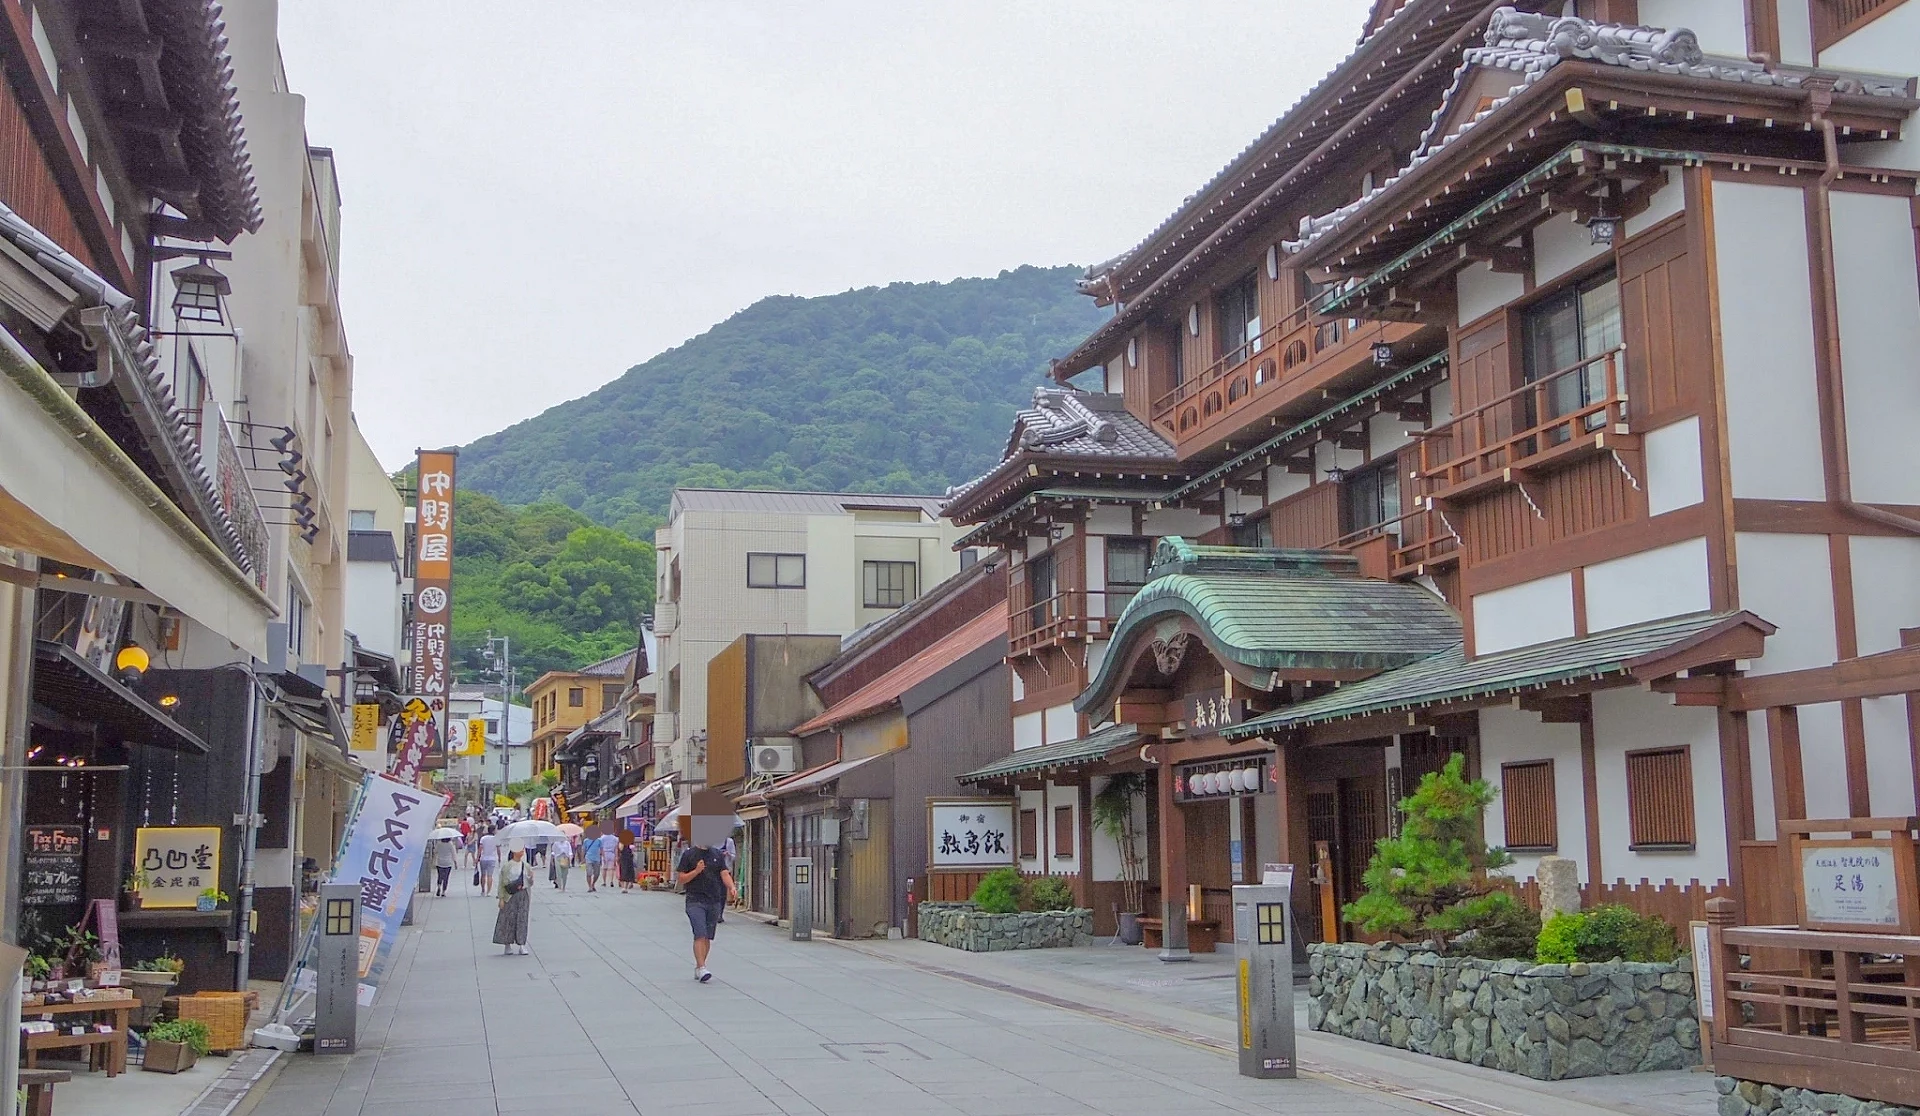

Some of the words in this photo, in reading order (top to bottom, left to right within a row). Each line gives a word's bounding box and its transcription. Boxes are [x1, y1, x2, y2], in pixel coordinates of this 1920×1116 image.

[421, 470, 451, 562] 中野屋
[415, 622, 426, 664] Nakano
[425, 622, 446, 693] 中野うどん
[414, 665, 426, 694] Udon
[958, 813, 986, 824] 御宿
[29, 830, 52, 848] Tax
[53, 830, 79, 845] Free
[142, 844, 213, 871] 凸凹堂
[1835, 873, 1864, 892] 足湯
